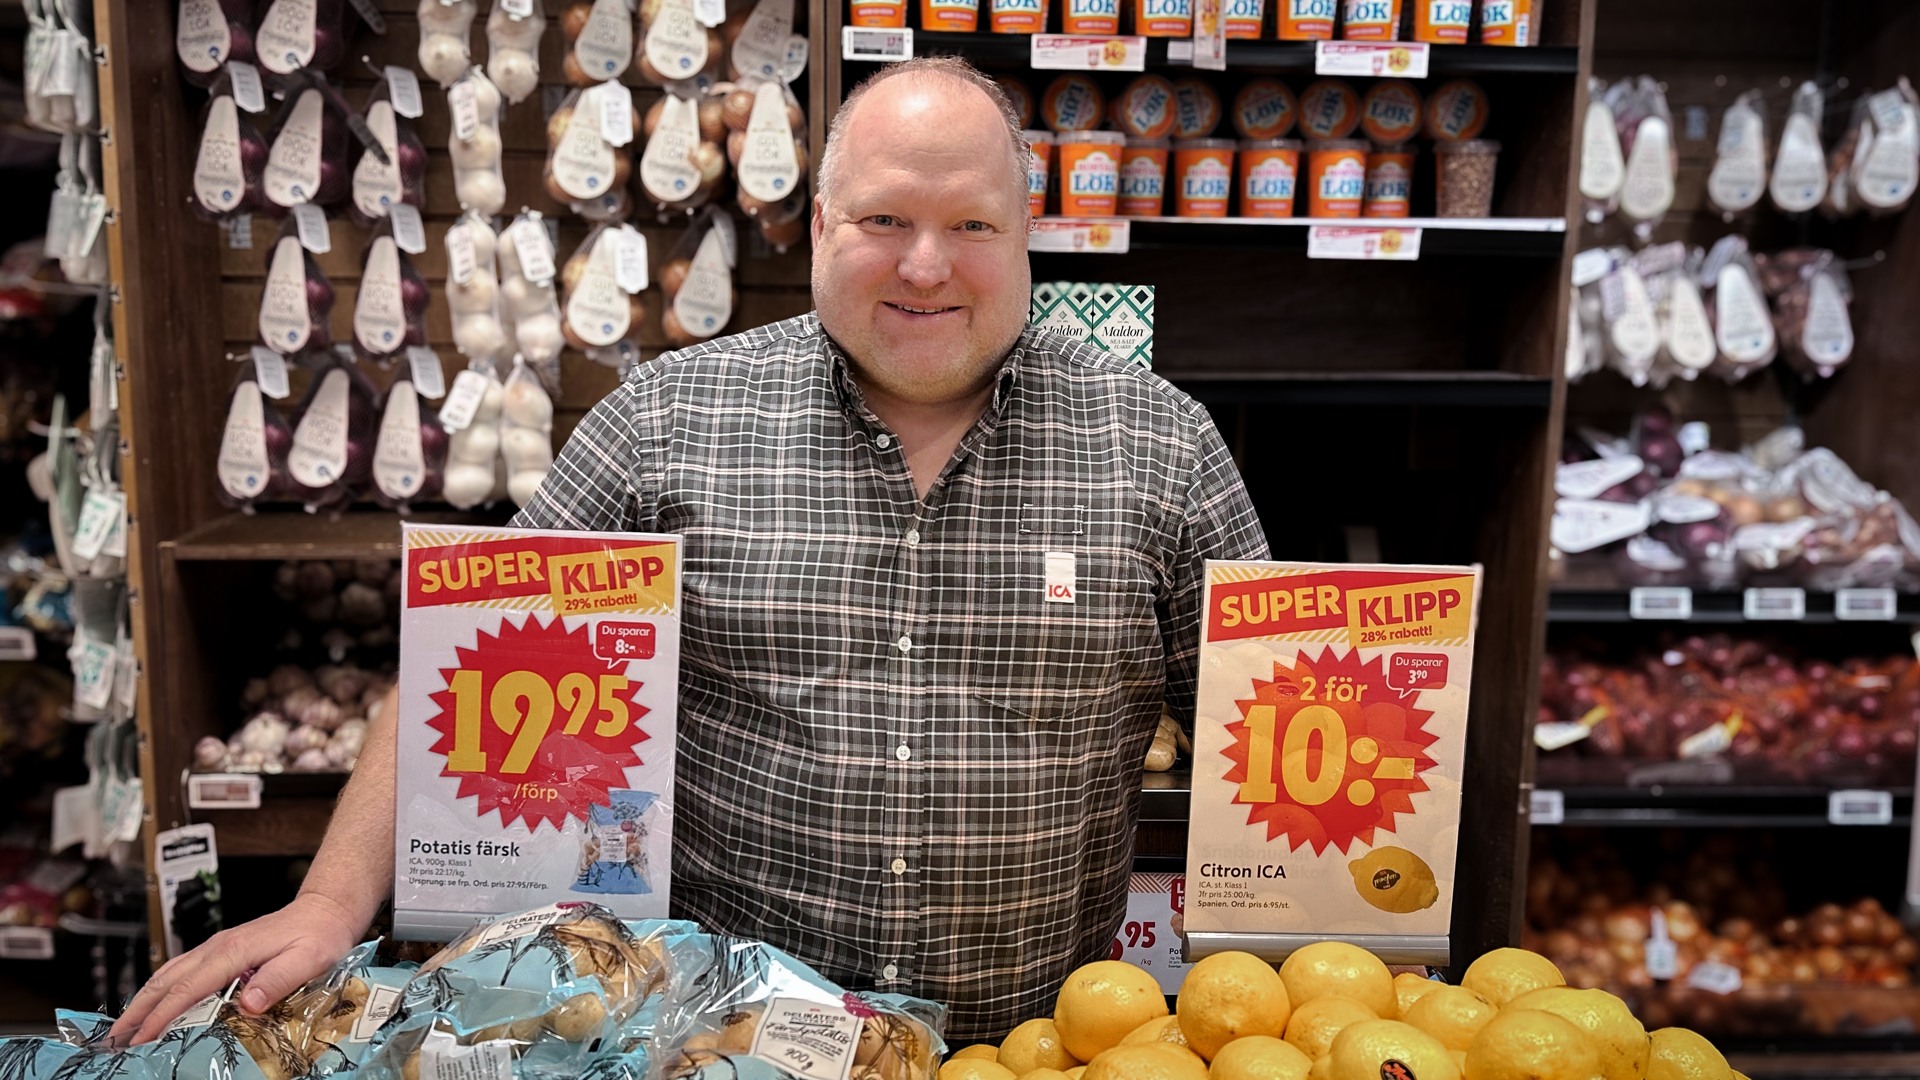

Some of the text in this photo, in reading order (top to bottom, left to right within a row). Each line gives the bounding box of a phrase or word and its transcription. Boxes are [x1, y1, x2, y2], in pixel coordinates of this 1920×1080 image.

[1074, 173, 1116, 191] LÖK
[1120, 176, 1160, 194] LÖK
[1187, 178, 1225, 195] LÖK
[1250, 178, 1290, 196] LÖK
[1102, 326, 1144, 337] Maldon
[418, 550, 664, 595] SUPER KLIPP
[1048, 585, 1072, 598] ICA
[565, 593, 638, 610] 29% rabatt!
[1220, 584, 1461, 628] SUPER KLIPP
[602, 625, 651, 638] Du sparar
[1360, 625, 1433, 643] 28% rabatt!
[1395, 657, 1443, 668] Du sparar
[1300, 676, 1368, 702] 2 för
[1239, 704, 1416, 807] 10:-
[513, 783, 559, 802] /förp
[410, 839, 520, 857] Potatis färsk
[448, 859, 467, 867] Klass
[468, 859, 472, 867] 1
[1200, 863, 1252, 878] Citron
[1256, 865, 1287, 879] ICA
[420, 868, 434, 876] pris
[408, 877, 447, 887] Ursprung:
[458, 879, 471, 888] frp.
[491, 880, 505, 888] pris
[1208, 891, 1222, 899] pris
[1198, 900, 1229, 908] Spanien.
[501, 911, 557, 926] DELIKATESS
[1140, 958, 1152, 966] /kg
[783, 1011, 847, 1022] DELIKATESS
